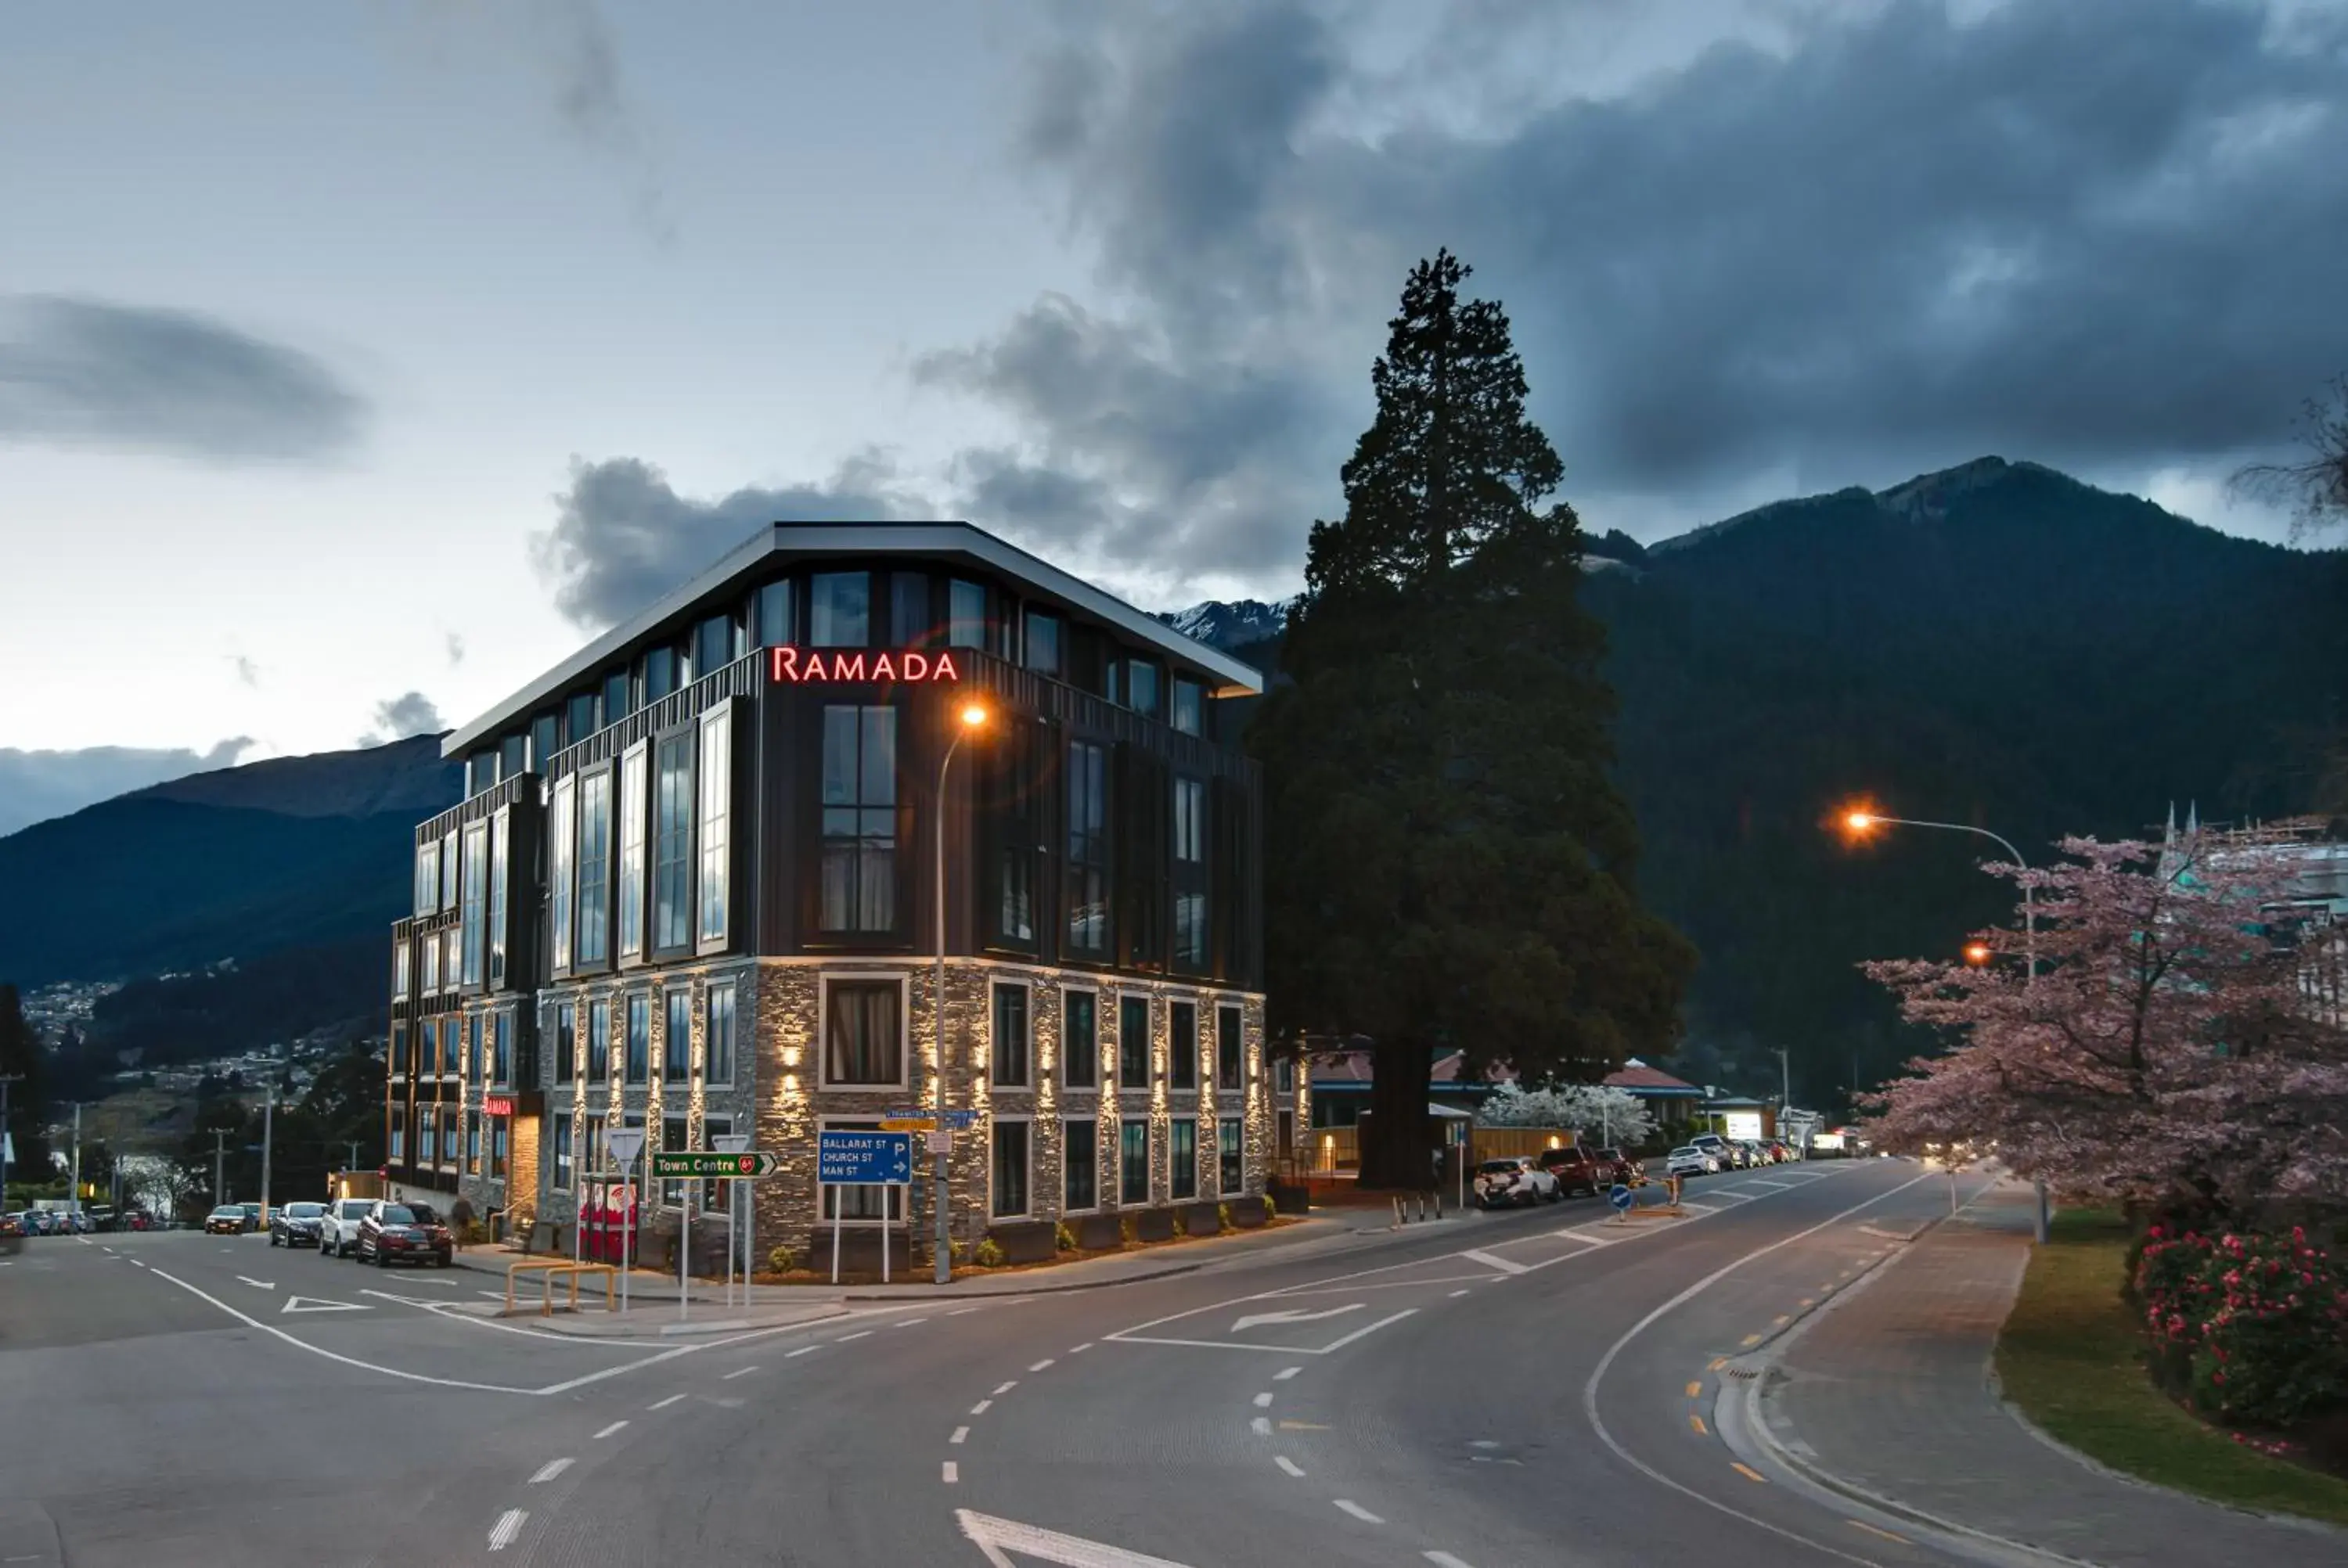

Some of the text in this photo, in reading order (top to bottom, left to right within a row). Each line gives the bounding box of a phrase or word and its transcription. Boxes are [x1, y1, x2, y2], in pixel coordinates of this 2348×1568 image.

[773, 647, 958, 682] RAMADA
[823, 1139, 886, 1149] BALLARAT ST
[895, 1143, 906, 1157] P
[823, 1153, 873, 1162] CHURCH ST
[657, 1159, 735, 1171] Town Centre
[823, 1166, 858, 1175] MAN ST
